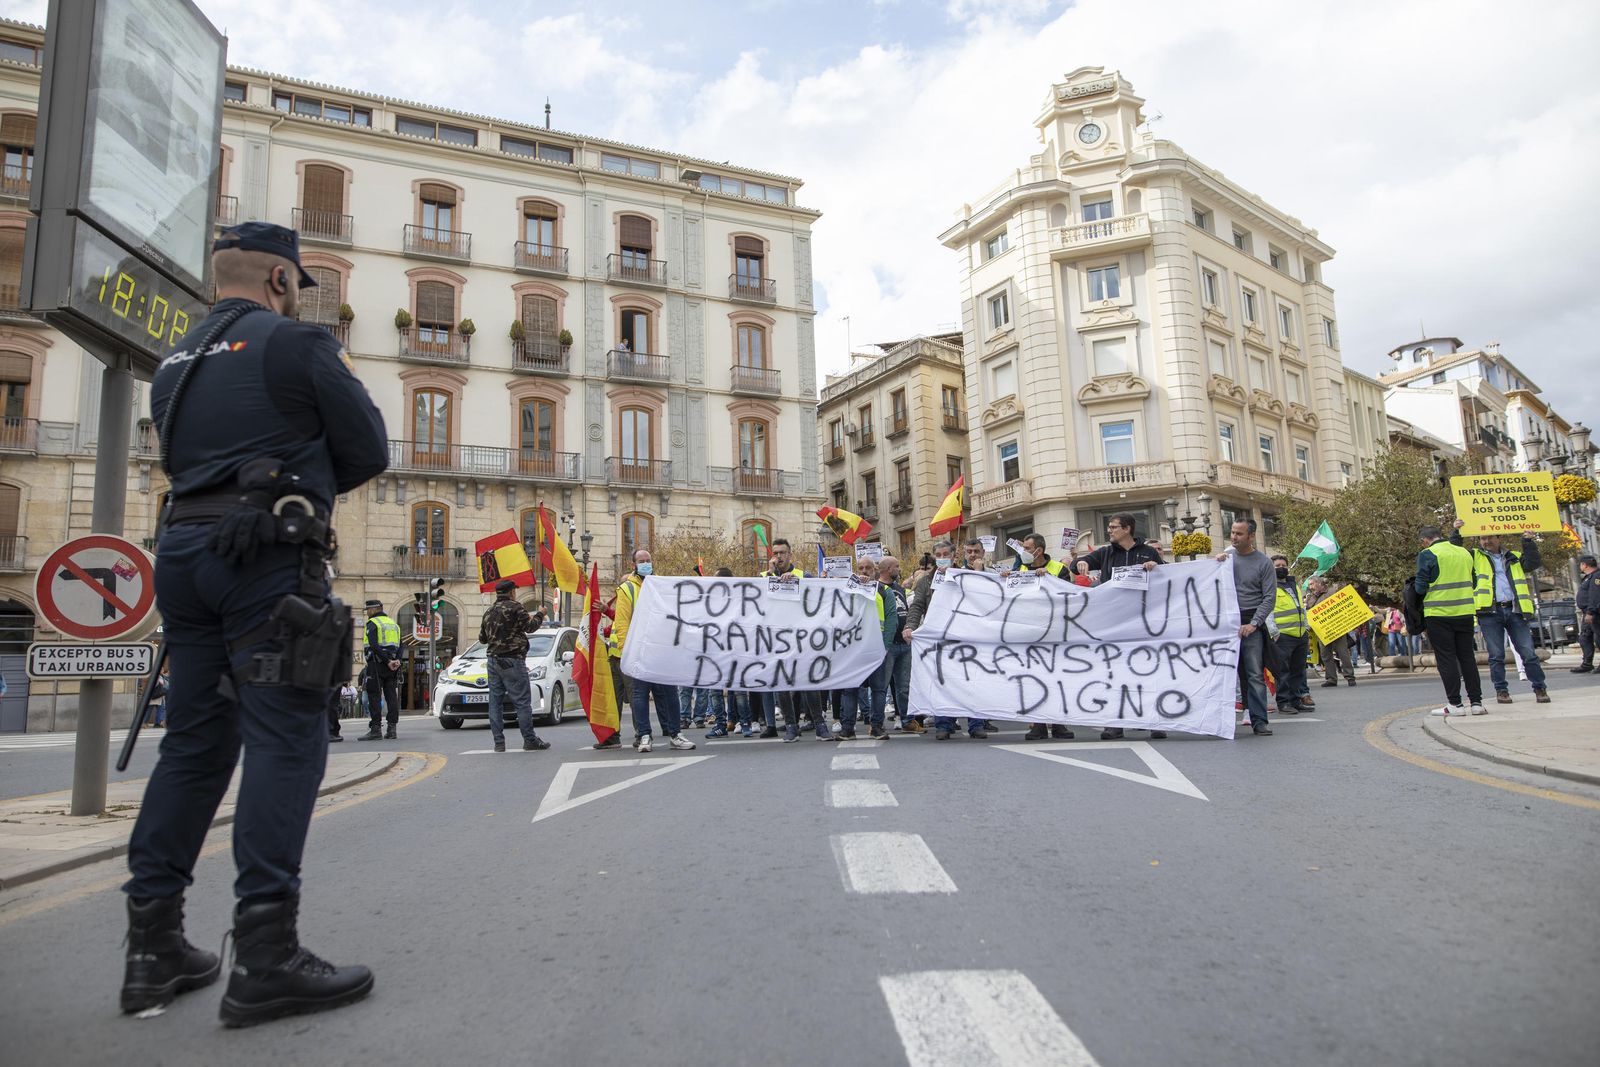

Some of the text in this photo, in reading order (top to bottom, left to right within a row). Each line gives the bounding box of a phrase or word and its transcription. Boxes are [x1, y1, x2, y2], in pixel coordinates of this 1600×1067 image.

[1458, 485, 1550, 496] IRRESPONSABLES
[1473, 476, 1528, 486] POLÍTICOS
[1472, 504, 1540, 514] NOS SOBRAN
[1498, 495, 1539, 503] CARCEL
[1491, 514, 1527, 522] TODOS
[673, 579, 765, 618] POR
[802, 586, 855, 618] UN
[942, 572, 1220, 643] POR UN
[1311, 591, 1347, 615] BASTA YA
[1320, 594, 1354, 617] TERRORISMO
[1318, 601, 1354, 625] INFORMATIVO
[666, 614, 863, 655] TRANSPORTE
[39, 648, 147, 658] EXCEPTO BUS Y
[920, 639, 1236, 685] TRANSPORTE
[38, 662, 145, 672] TAXI URBANOS
[693, 655, 832, 689] DIGNO
[466, 695, 483, 703] 7259
[1009, 674, 1192, 719] DIGNO
